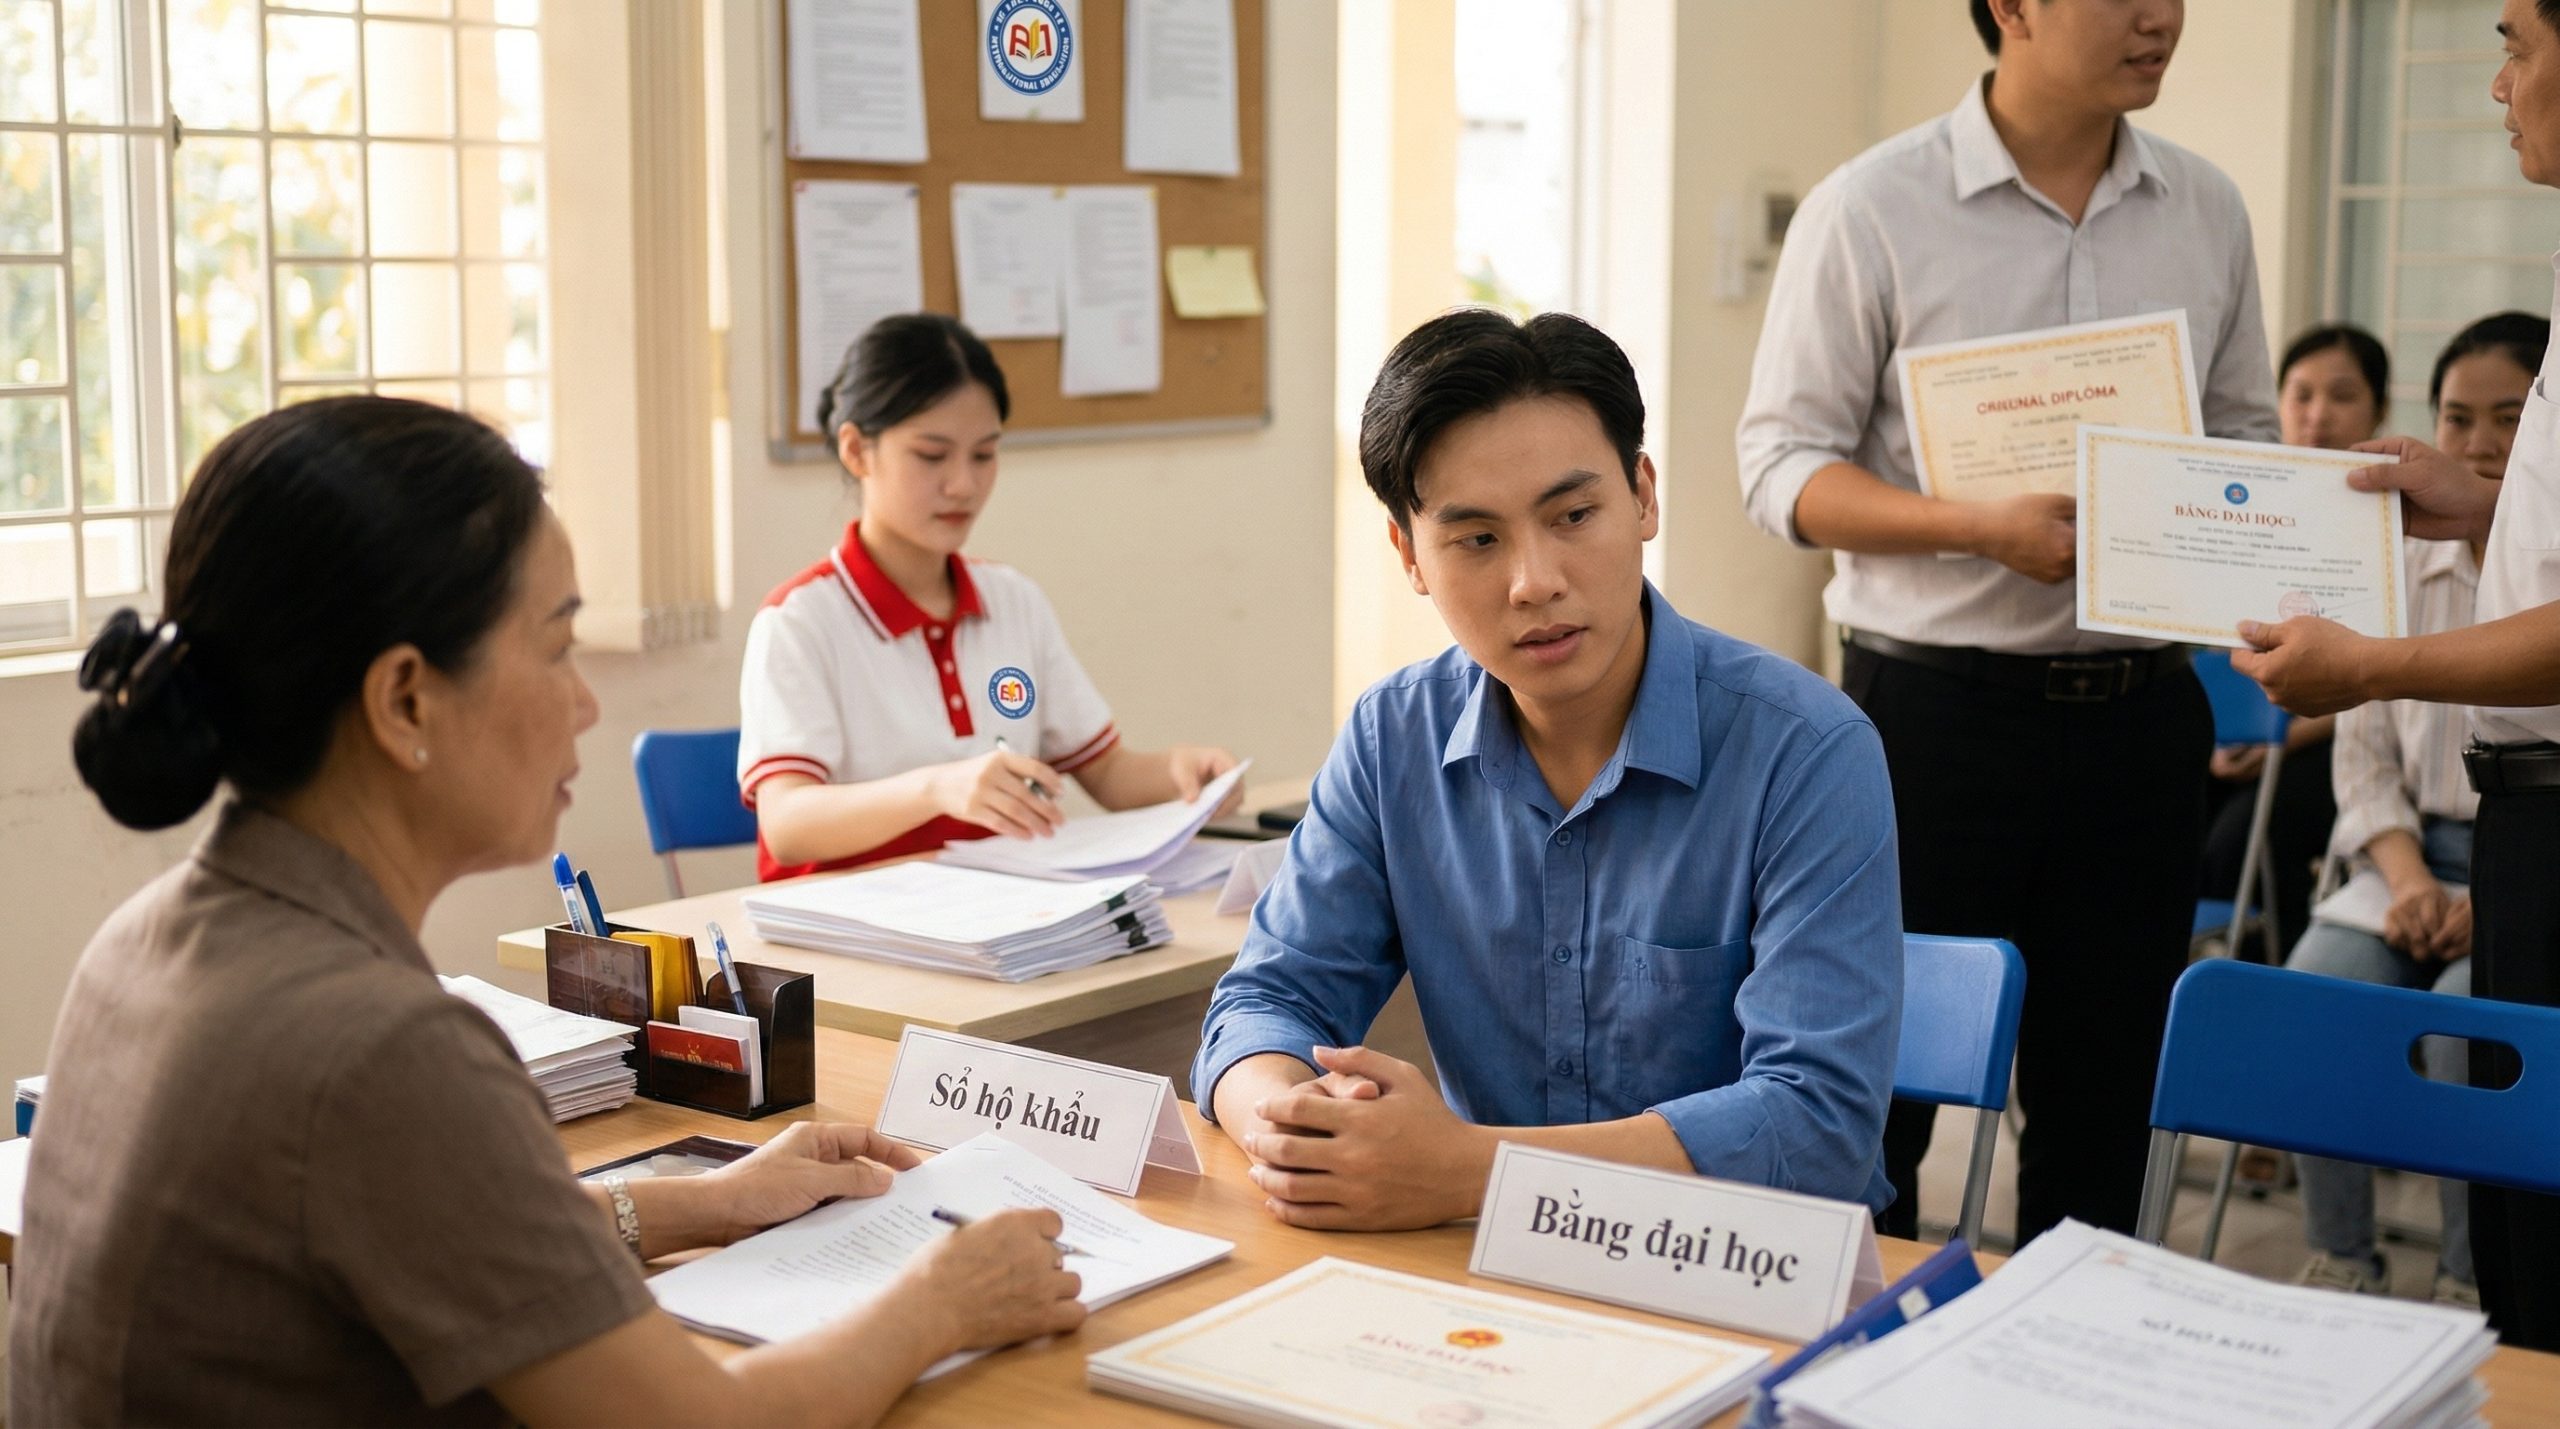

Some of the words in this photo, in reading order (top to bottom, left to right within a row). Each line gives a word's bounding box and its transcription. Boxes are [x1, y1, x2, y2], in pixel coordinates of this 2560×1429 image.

[929, 1066, 972, 1111] Sổ
[974, 1082, 1015, 1130] hộ
[1019, 1090, 1101, 1142] khẩu
[1528, 1188, 1634, 1261] Bằng
[1644, 1218, 1712, 1272] đại
[1720, 1230, 1799, 1288] học
